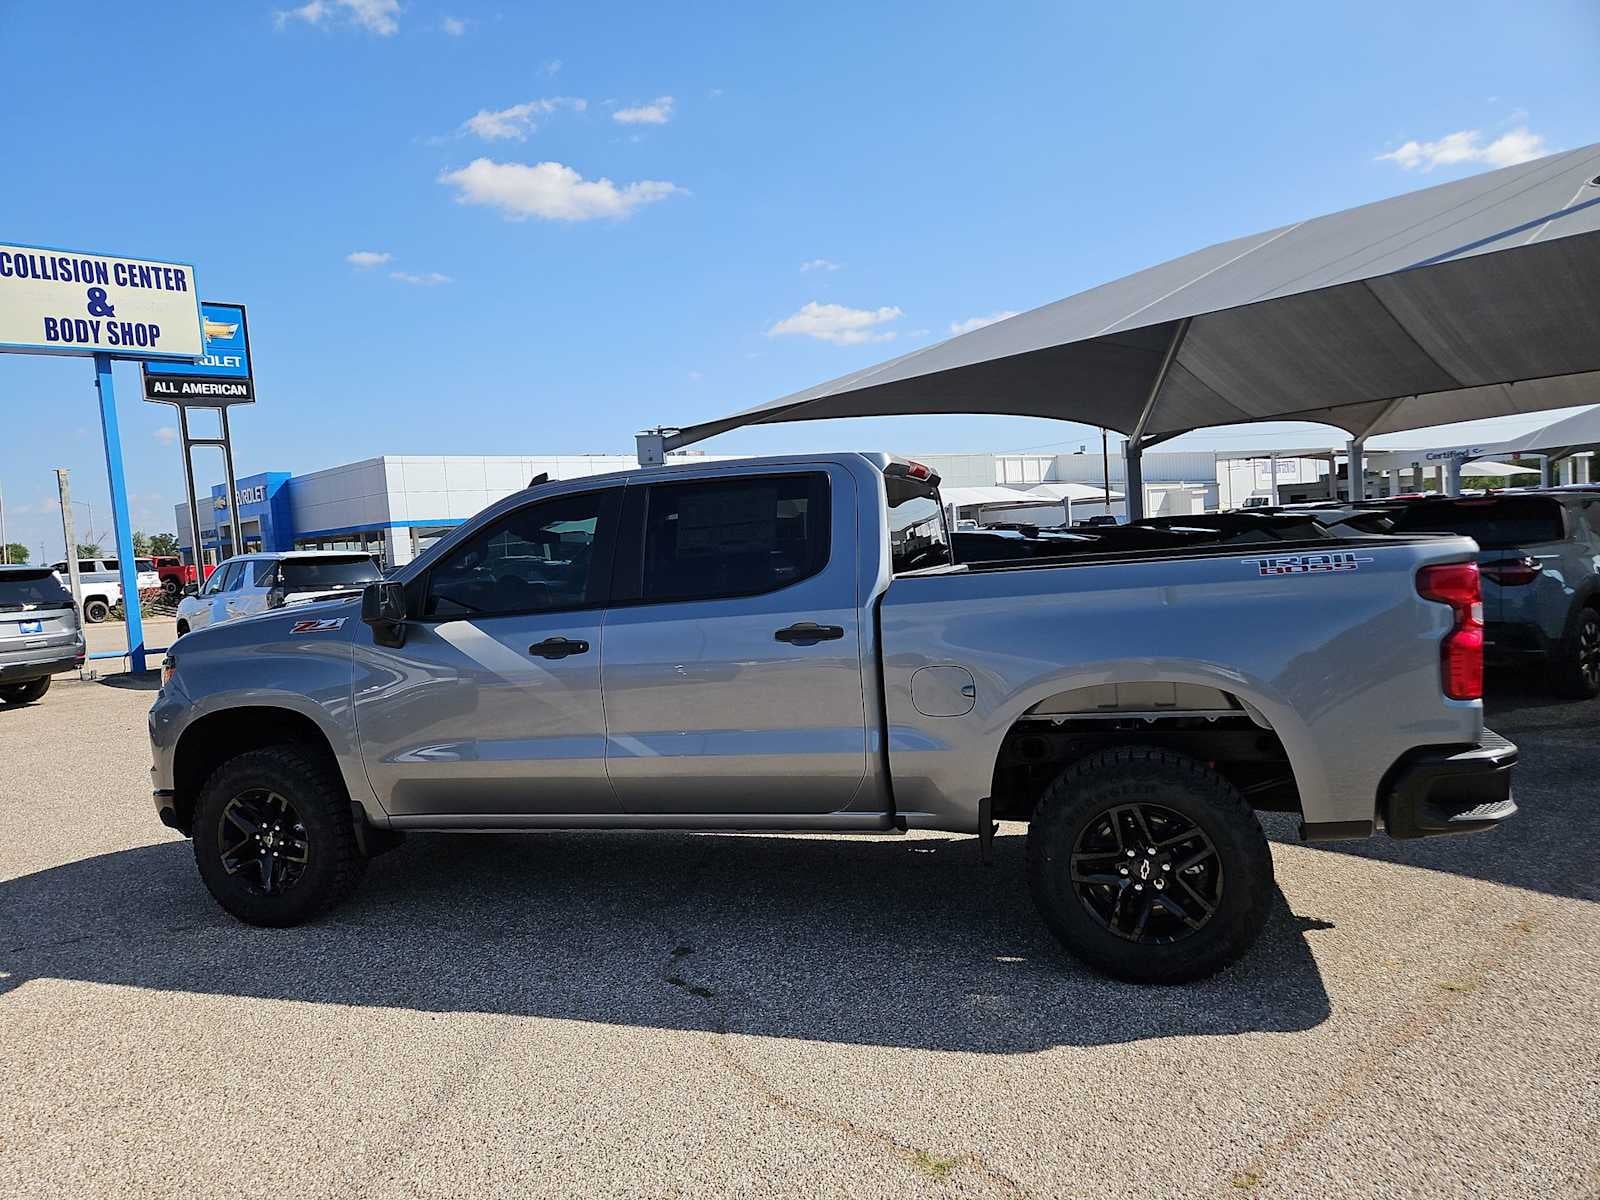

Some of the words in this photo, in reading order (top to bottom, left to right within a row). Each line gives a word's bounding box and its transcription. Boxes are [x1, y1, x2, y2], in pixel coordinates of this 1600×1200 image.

[0, 251, 109, 285] COLLISION
[113, 262, 187, 292] CENTER
[87, 287, 116, 317] &
[44, 317, 100, 344] BODY
[106, 323, 161, 347] SHOP
[153, 381, 178, 393] ALL
[181, 382, 247, 396] AMERICAN
[289, 616, 350, 634] Z71
